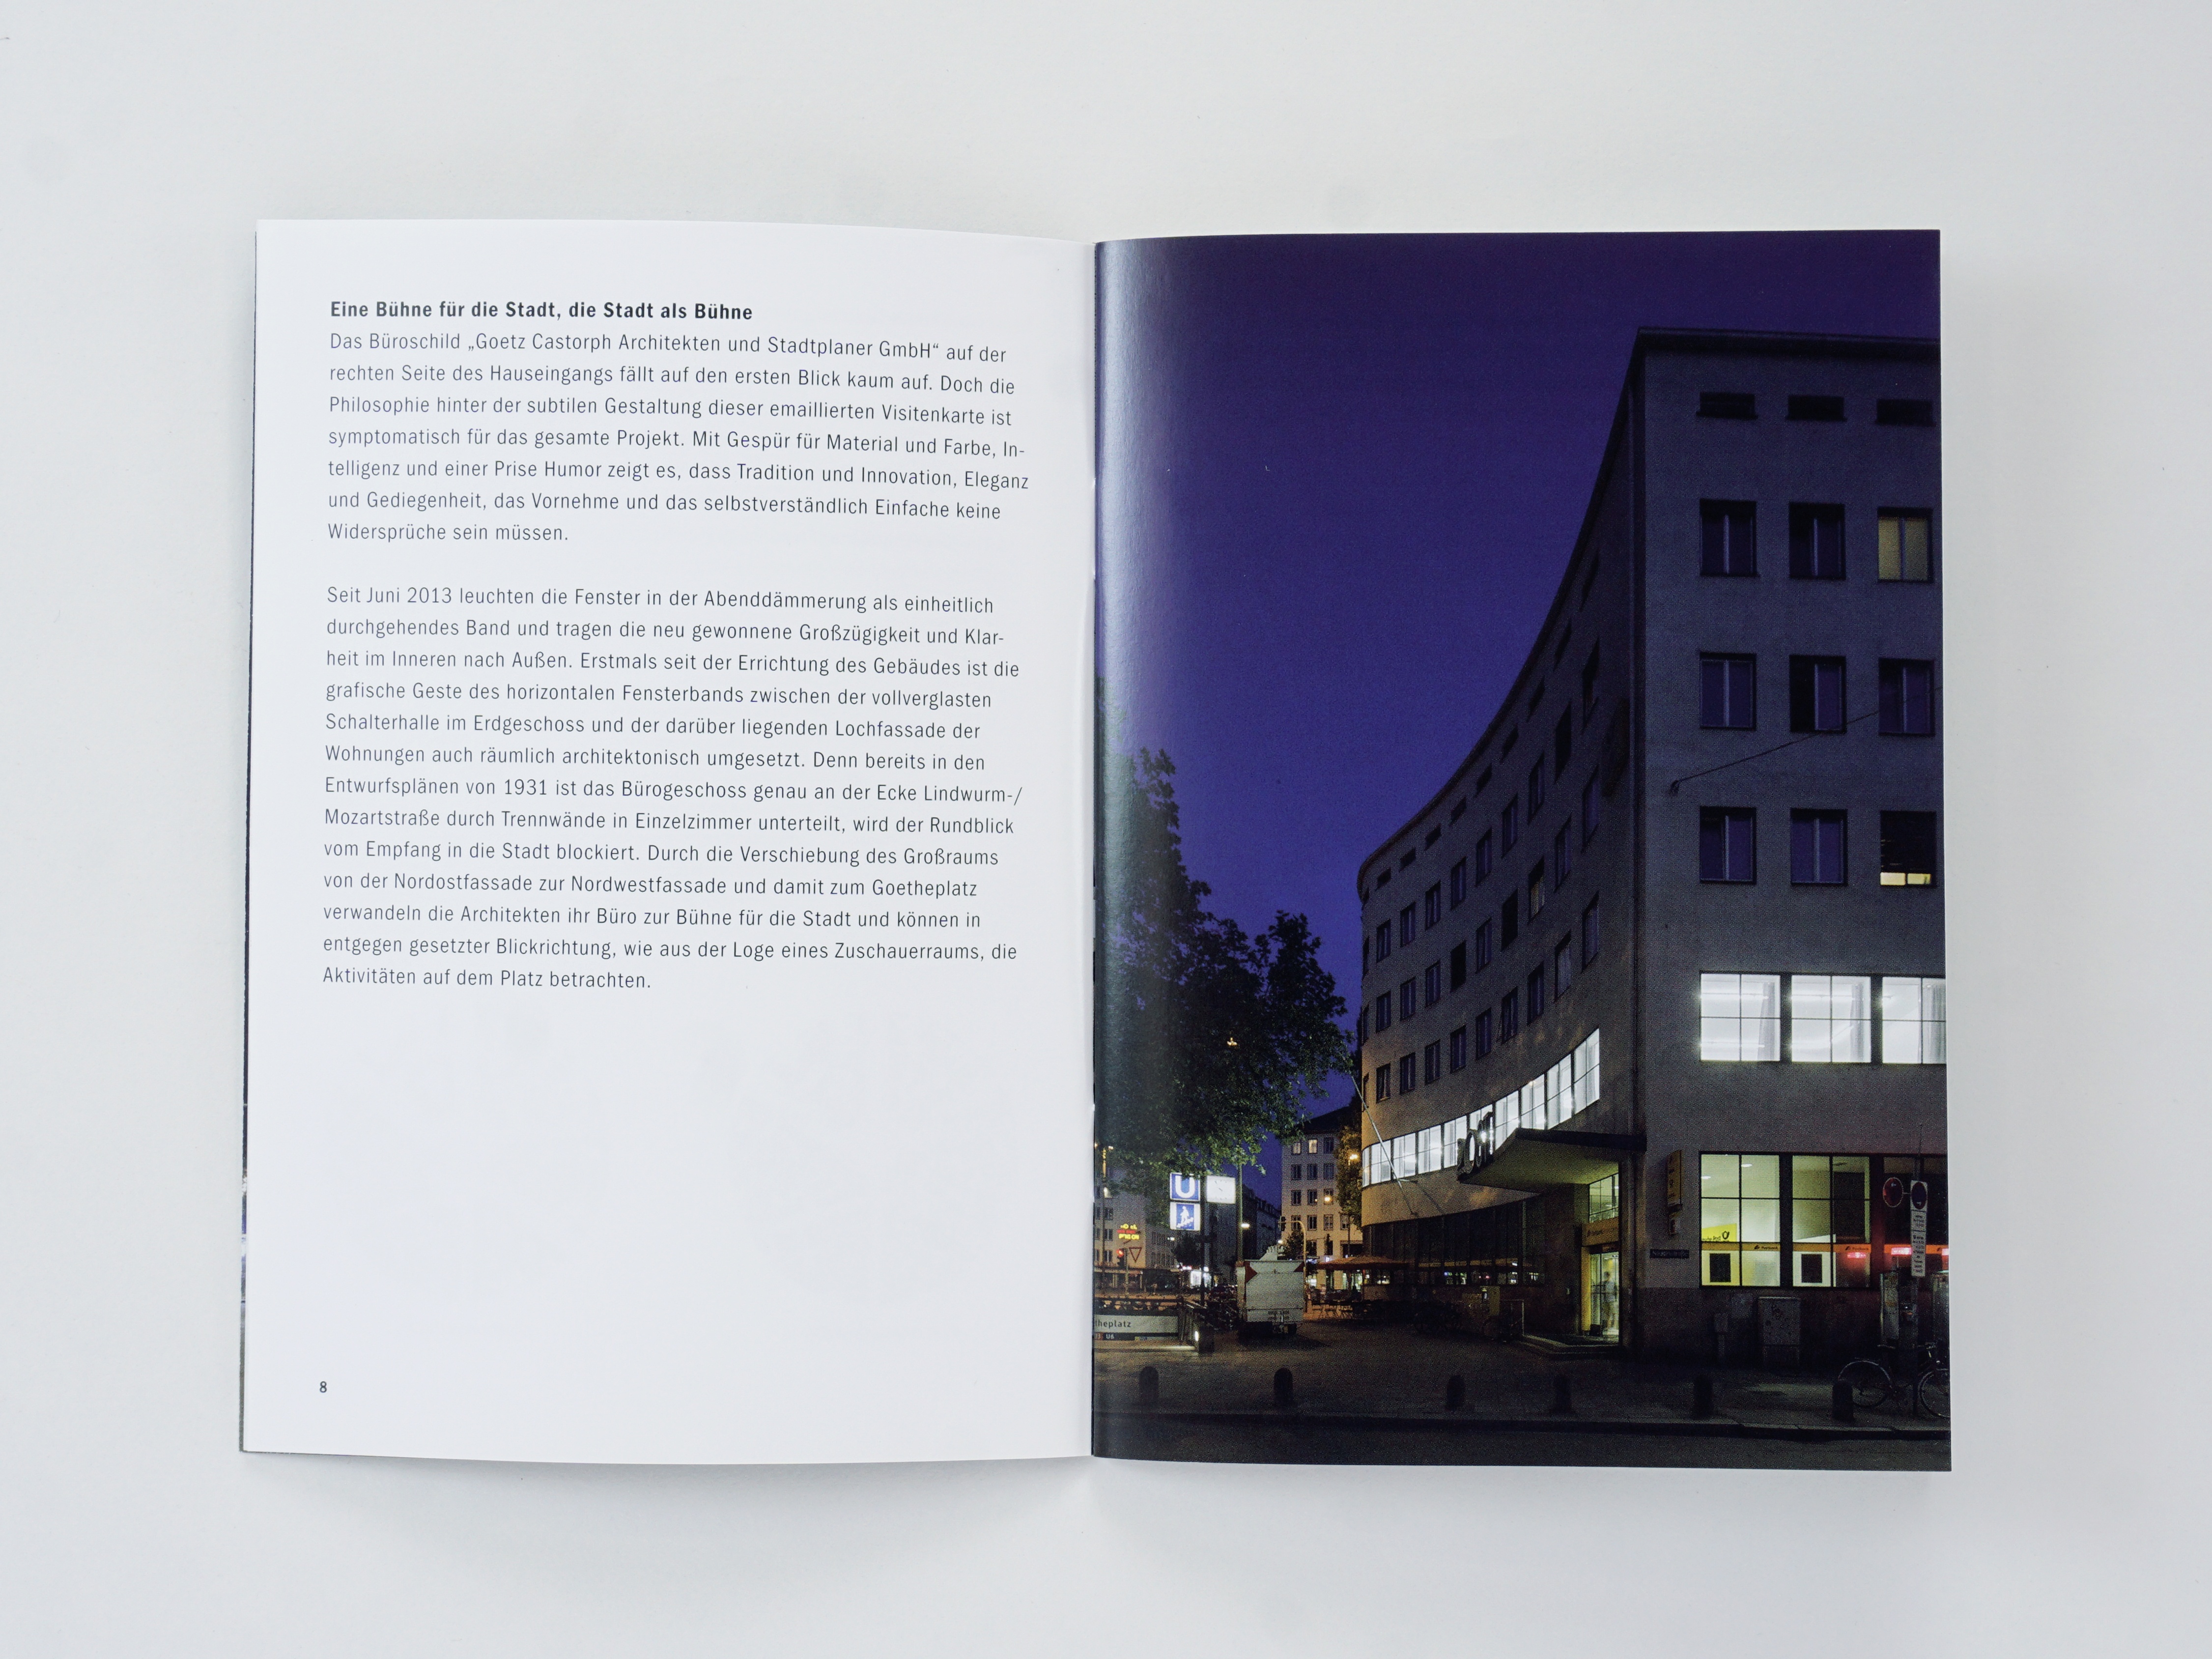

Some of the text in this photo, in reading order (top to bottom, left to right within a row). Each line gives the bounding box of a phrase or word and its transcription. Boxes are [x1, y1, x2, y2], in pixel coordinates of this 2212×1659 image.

[331, 300, 753, 321] Eine Bühne für die Stadt, die Stadt als Bühne
[331, 333, 1006, 363] Das Büroschild „Goetz Castorph Architekten und Stadtplaner GmbH“ auf der
[330, 364, 1015, 395] rechten Seite des Hauseingangs fällt auf den ersten Blick kaum auf. Doch die
[329, 428, 1025, 459] symptomatisch für das gesamte Projekt. Mit Gespür für Material und Farbe, In-
[328, 459, 1028, 492] telligenz und einer Prise Humor zeigt es, dass Tradition und Innovation, Eleganz
[328, 523, 568, 543] Widersprüche sein müssen.
[327, 586, 993, 614] Seit Juni 2013 leuchten die Fenster in der Abenddämmerung als einheitlich
[327, 650, 1019, 677] heit im Inneren nach Außen. Erstmals seit der Errichtung des Gebäudes ist die
[326, 713, 980, 739] Schalterhalle im Erdgeschoss und der darüber liegenden Lochfassade der
[326, 776, 1023, 806] Entwurfsplänen von 1931 ist das Bürogeschoss genau an der Ecke Lindwurm-/
[324, 840, 998, 867] vom Empfang in die Stadt blockiert. Durch die Verschiebung des Großraums
[323, 904, 980, 928] verwandeln die Architekten ihr Büro zur Bühne für die Stadt und können in
[323, 937, 1017, 962] entgegen gesetzter Blickrichtung, wie aus der Loge eines Zuschauerraums, die
[323, 967, 651, 988] Aktivitäten auf dem Platz betrachten.
[1175, 1175, 1195, 1199] U
[319, 1381, 327, 1393] 8
